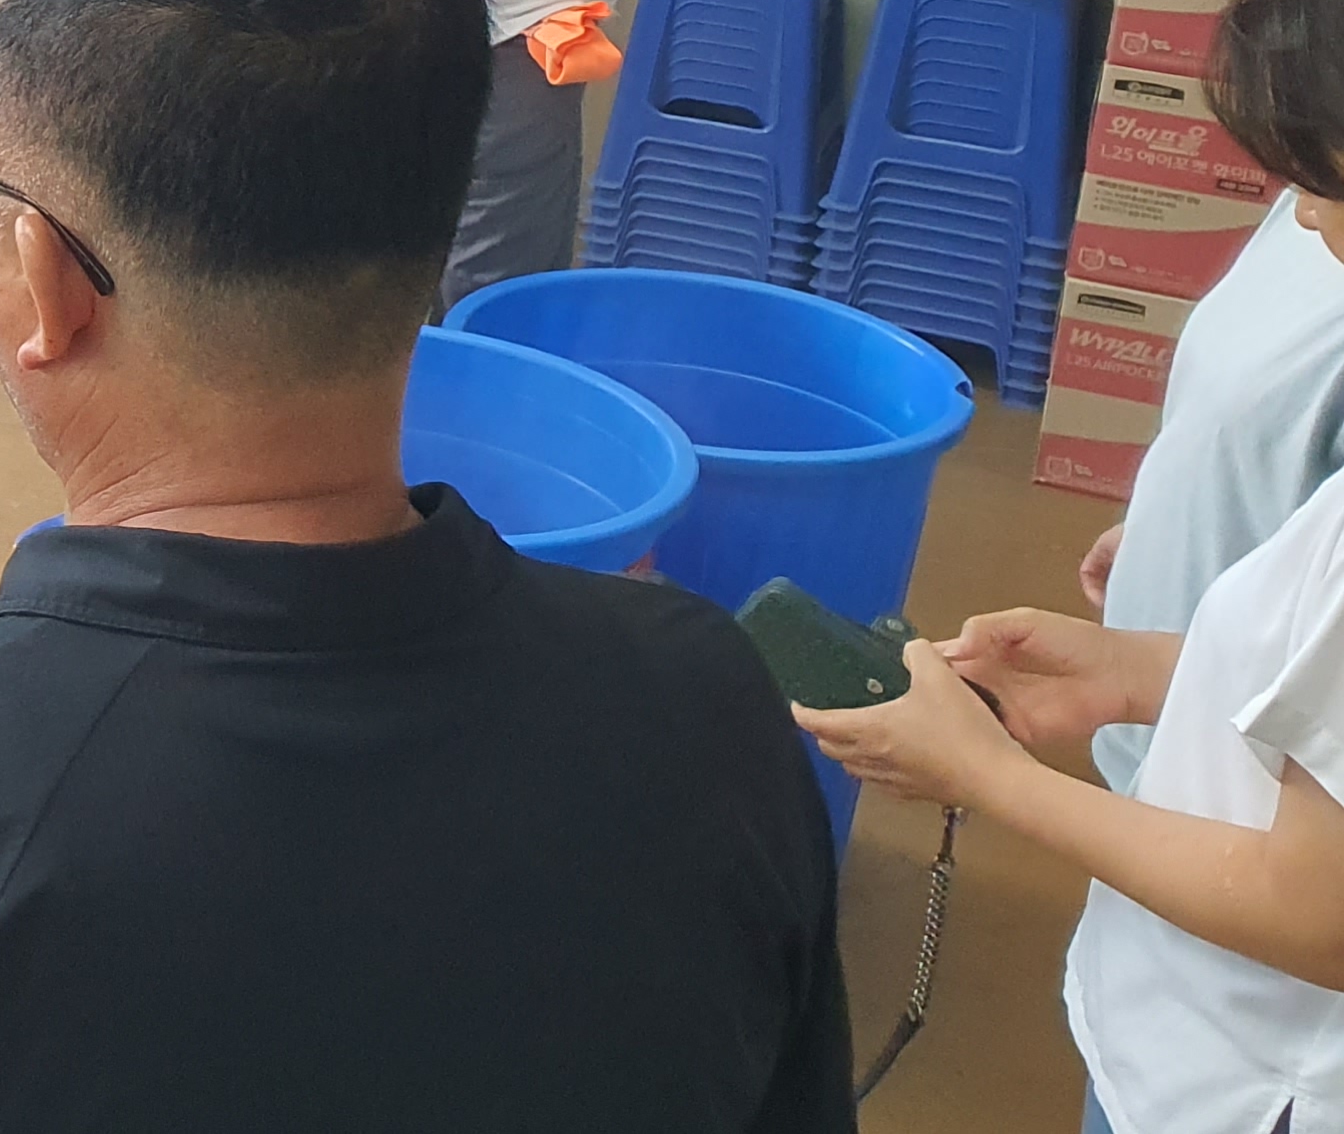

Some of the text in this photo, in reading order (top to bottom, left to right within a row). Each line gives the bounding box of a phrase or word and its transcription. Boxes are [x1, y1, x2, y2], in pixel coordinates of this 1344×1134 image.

[1105, 115, 1209, 157] 와이프올
[1100, 143, 1135, 163] L25
[1066, 352, 1092, 369] L25
